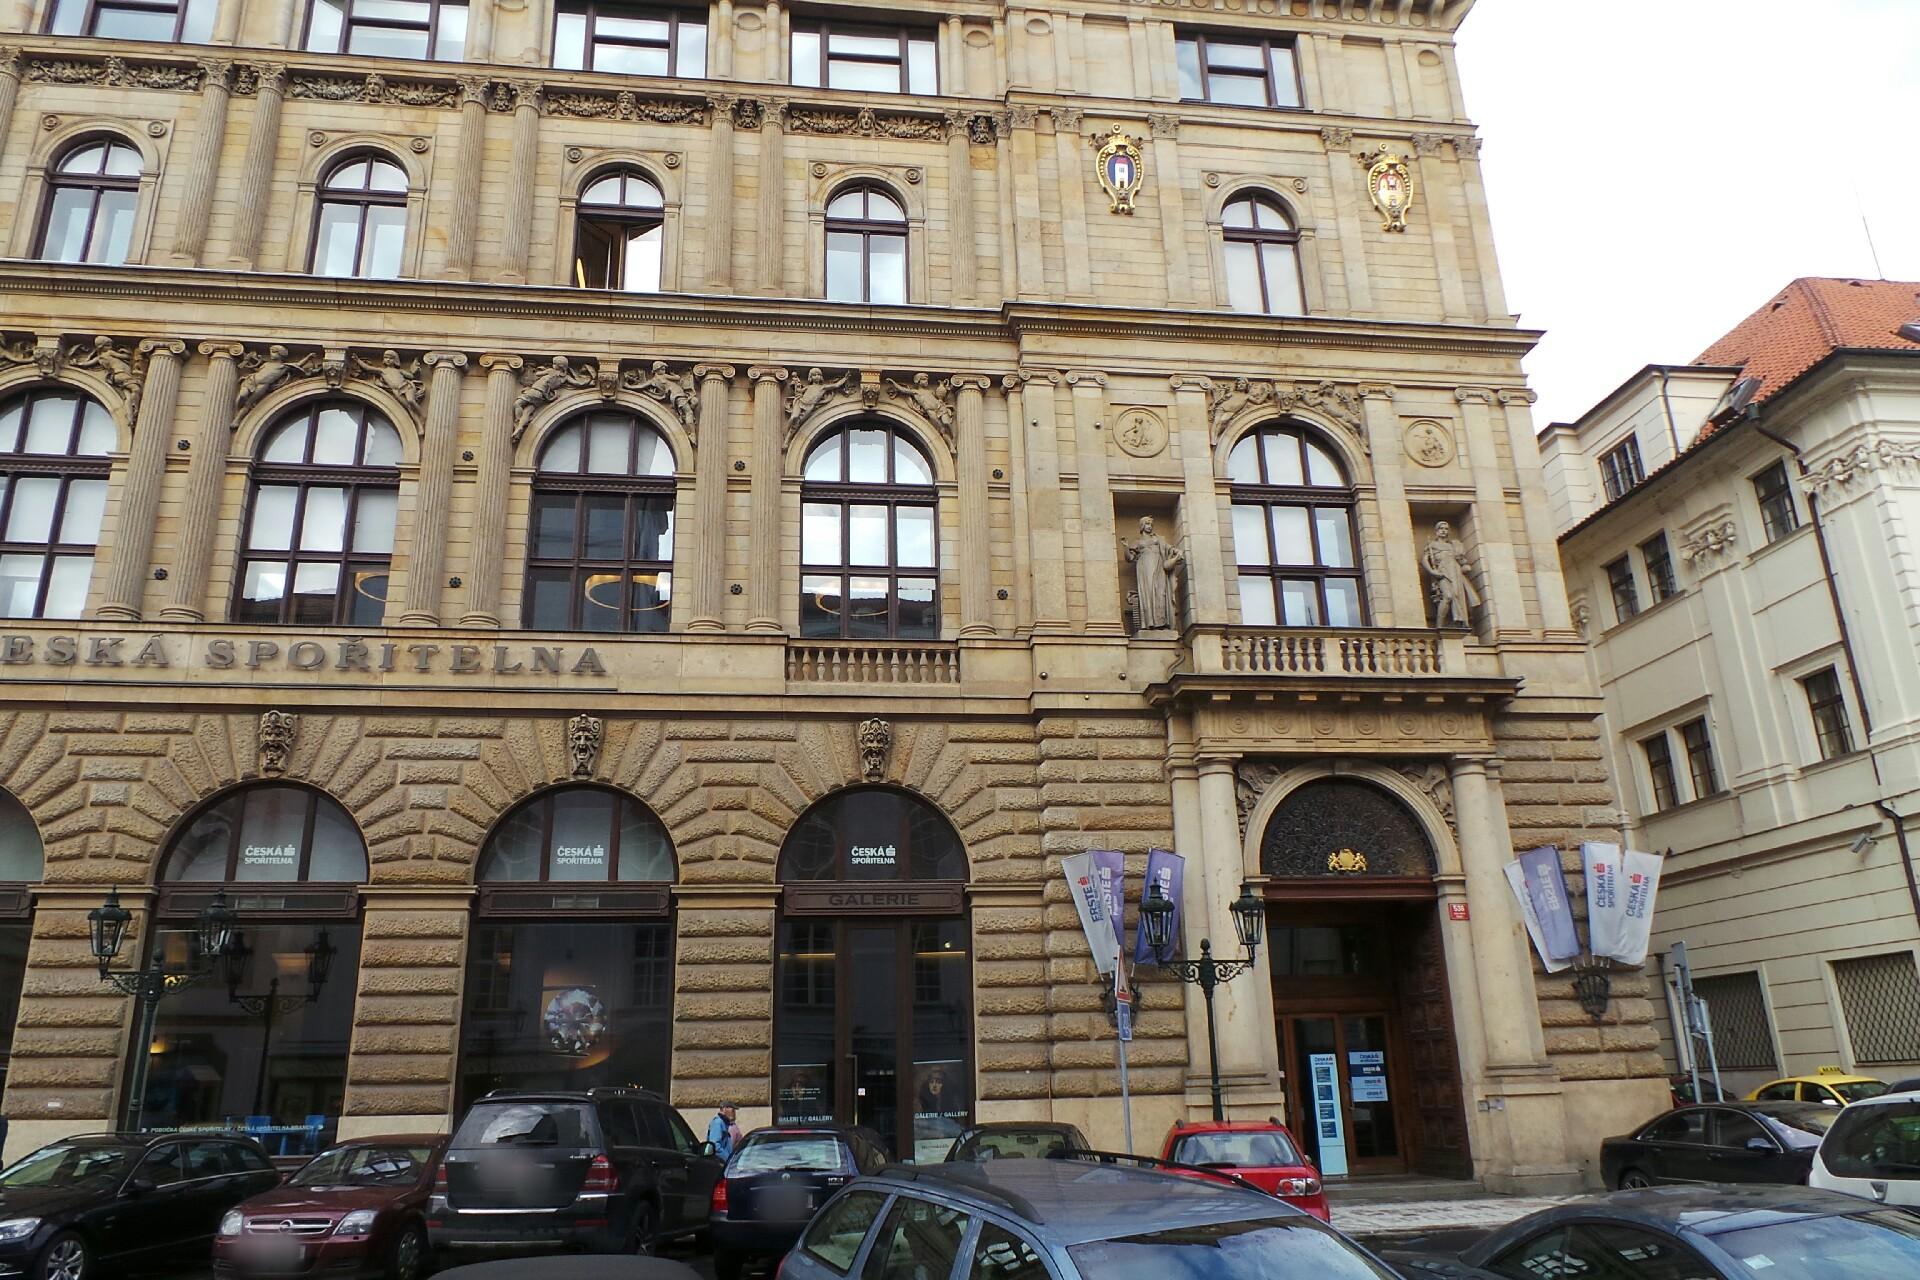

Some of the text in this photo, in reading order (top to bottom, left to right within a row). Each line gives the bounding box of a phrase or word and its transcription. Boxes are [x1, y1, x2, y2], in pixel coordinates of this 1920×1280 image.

[205, 637, 606, 673] SPOŘITELNA
[245, 844, 282, 856] ČESKÁ
[557, 845, 592, 856] ČESKÁ
[851, 846, 885, 857] ČESKÁ
[829, 894, 919, 906] GALERIE
